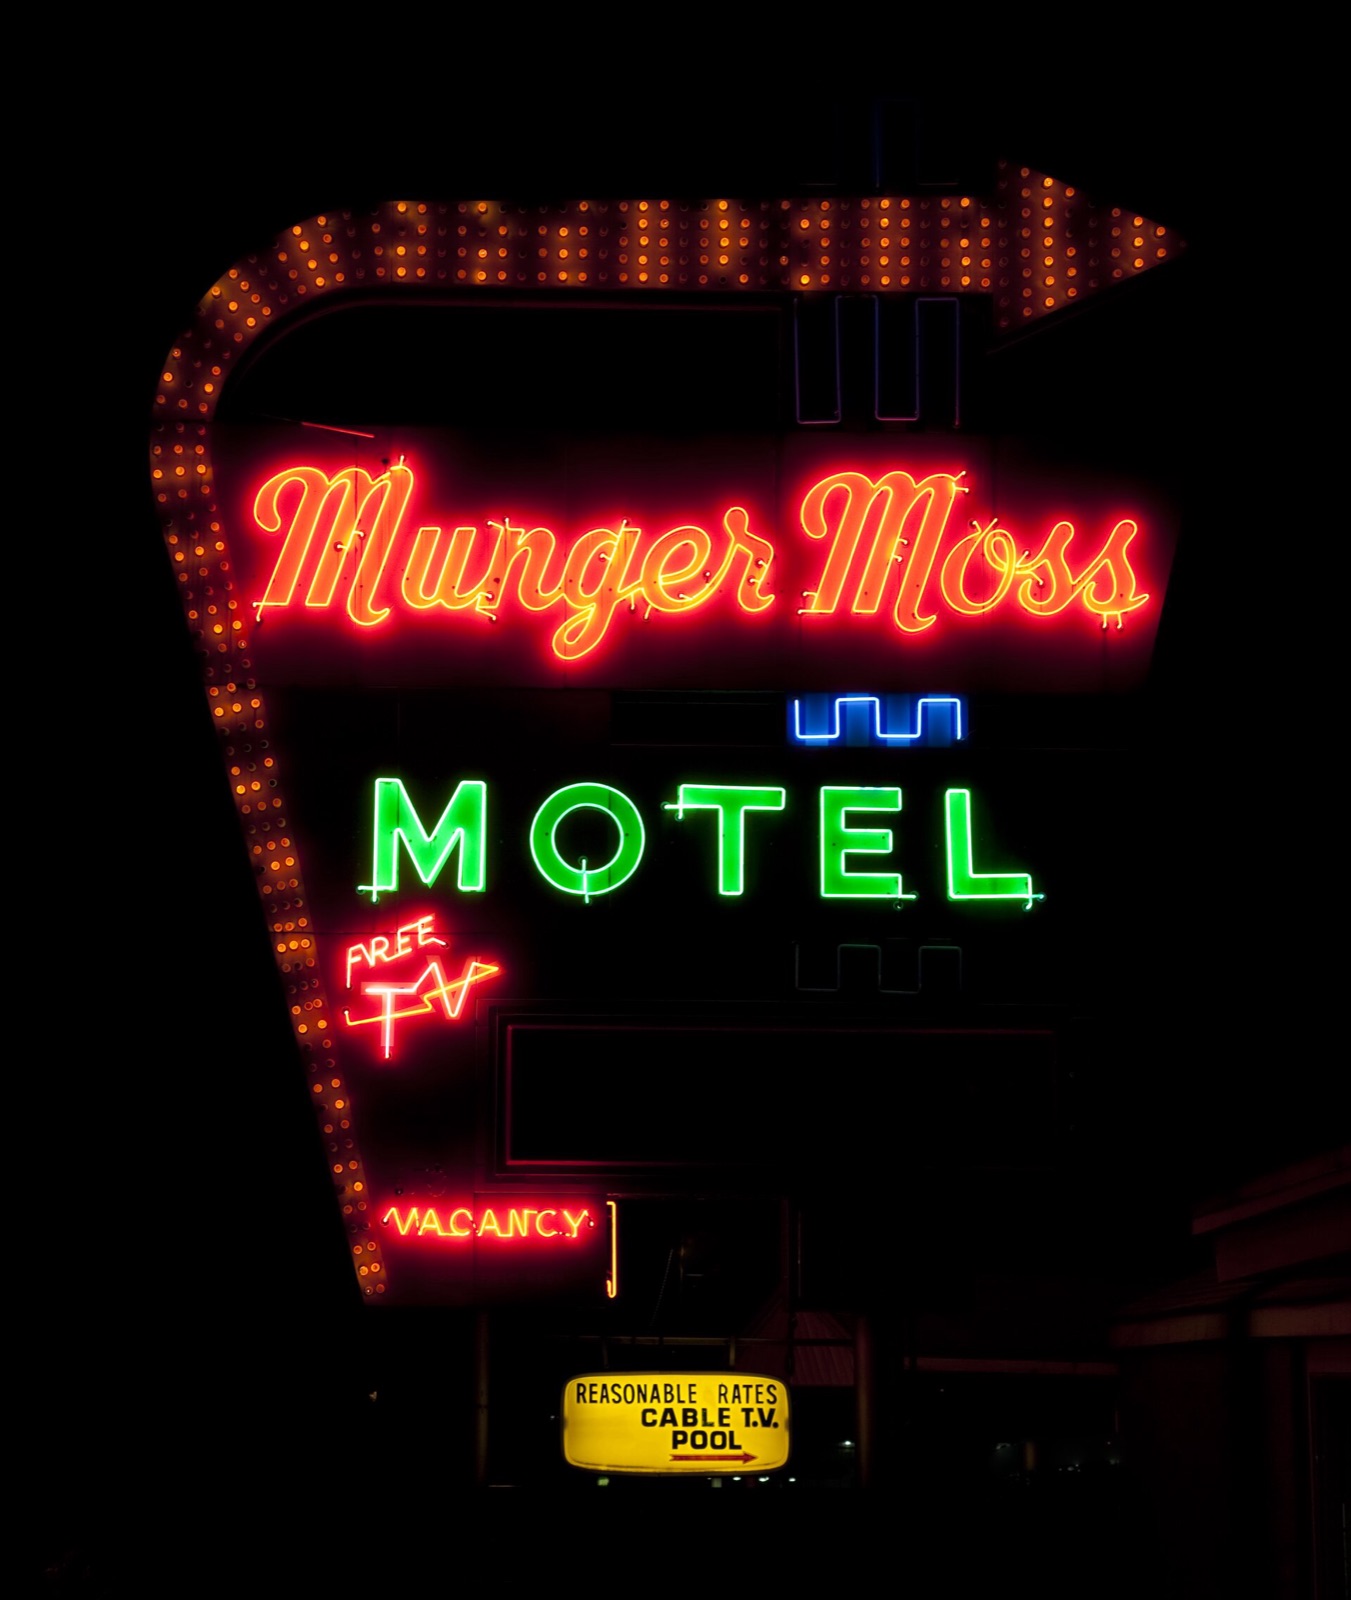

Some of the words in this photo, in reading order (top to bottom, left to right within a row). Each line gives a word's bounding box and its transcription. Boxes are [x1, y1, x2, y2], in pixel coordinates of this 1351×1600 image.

[253, 457, 775, 659] Munger
[799, 471, 1149, 632] Moss
[365, 777, 1040, 906] MOTEL
[345, 914, 447, 989] FREE
[361, 955, 482, 1058] TV
[383, 1206, 594, 1238] VACANCY
[576, 1383, 697, 1404] REASONABLE
[718, 1384, 777, 1405] RATES
[641, 1407, 731, 1428] CABLE
[741, 1408, 779, 1429] T.V.
[671, 1430, 742, 1450] POOL
